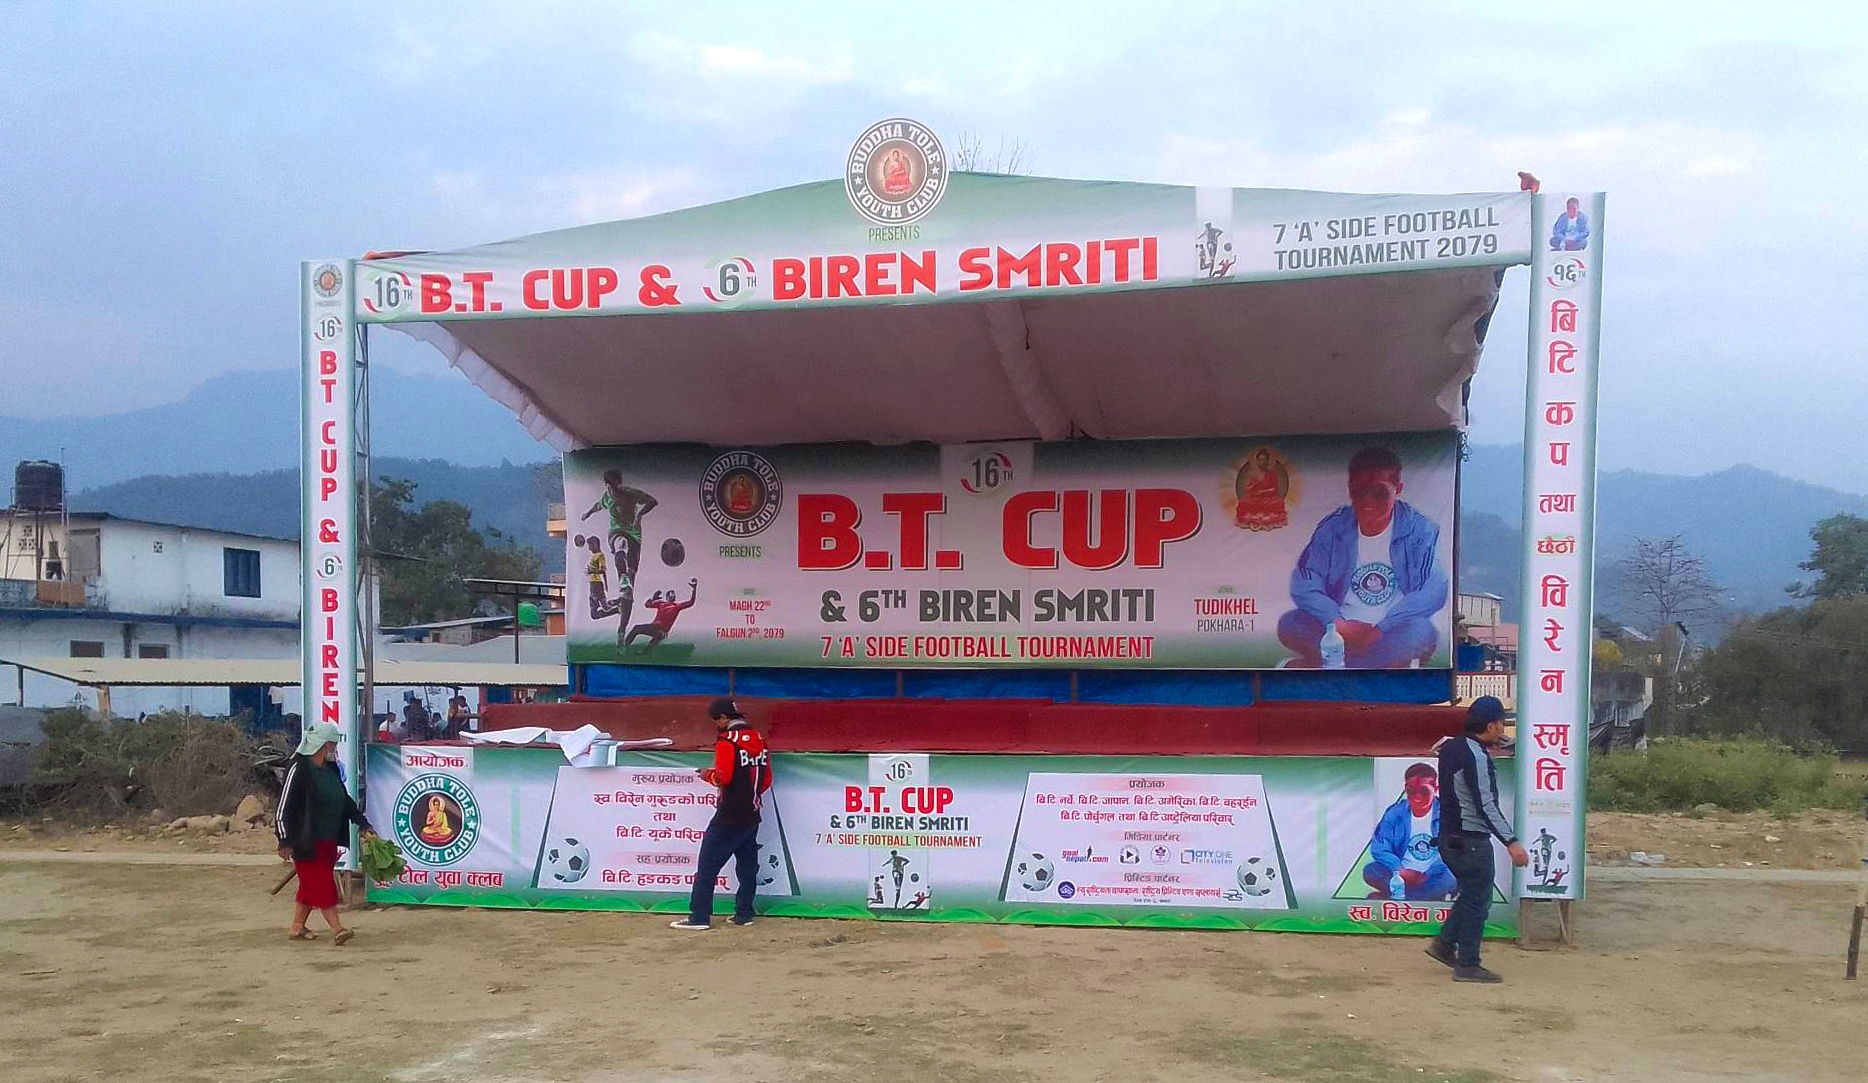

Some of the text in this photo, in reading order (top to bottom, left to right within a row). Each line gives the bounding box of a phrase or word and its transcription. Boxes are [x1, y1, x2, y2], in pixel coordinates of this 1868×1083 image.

[852, 124, 941, 174] BUDDHA TOLE
[856, 178, 939, 218] YOUTH CLUB
[868, 226, 920, 241] PRESENTS
[1273, 223, 1286, 245] 7
[1327, 215, 1377, 239] SIDE
[1384, 207, 1500, 235] FOOTBALL
[1274, 233, 1498, 271] TOURNAMENT 2079
[420, 272, 502, 313] B.T.
[520, 266, 618, 311] CUP
[639, 267, 682, 307] &
[772, 249, 938, 301] BIREN
[957, 236, 1159, 292] SMRITI
[704, 454, 779, 492] BUDDHA TOLE
[1539, 494, 1577, 513] तथा
[706, 502, 776, 533] YOUTH CLUB
[319, 518, 340, 544] &
[797, 489, 1204, 571] B.T. CUP
[719, 545, 762, 557] PRESENTS
[729, 601, 753, 611] MAGH
[820, 588, 1155, 624] & 6TH BIREN SMRITI
[1193, 598, 1259, 615] TUDIKHEL
[745, 614, 756, 625] TO
[1197, 619, 1254, 632] POKHARA-1
[716, 627, 746, 639] FALGUN
[763, 628, 784, 639] 2079
[821, 636, 832, 658] 7
[865, 636, 908, 658] SIDE
[913, 636, 1012, 659] FOOTBALL
[1016, 636, 1155, 659] TOURNAMENT
[406, 753, 465, 768] आयोजक
[398, 777, 476, 818] BUDDHA TOLE
[845, 786, 954, 814] B.T. CUP
[653, 811, 677, 822] तथा
[830, 815, 842, 829] &
[871, 815, 914, 831] BIREN
[919, 816, 969, 831] SMRITI
[399, 827, 475, 863] YOUTH CLUB
[816, 834, 822, 844] 7
[838, 834, 860, 845] SIDE
[863, 834, 911, 846] FOOTBALL
[914, 835, 982, 848] TOURNAMENT
[1195, 850, 1214, 858] CITY
[434, 870, 462, 888] युवा
